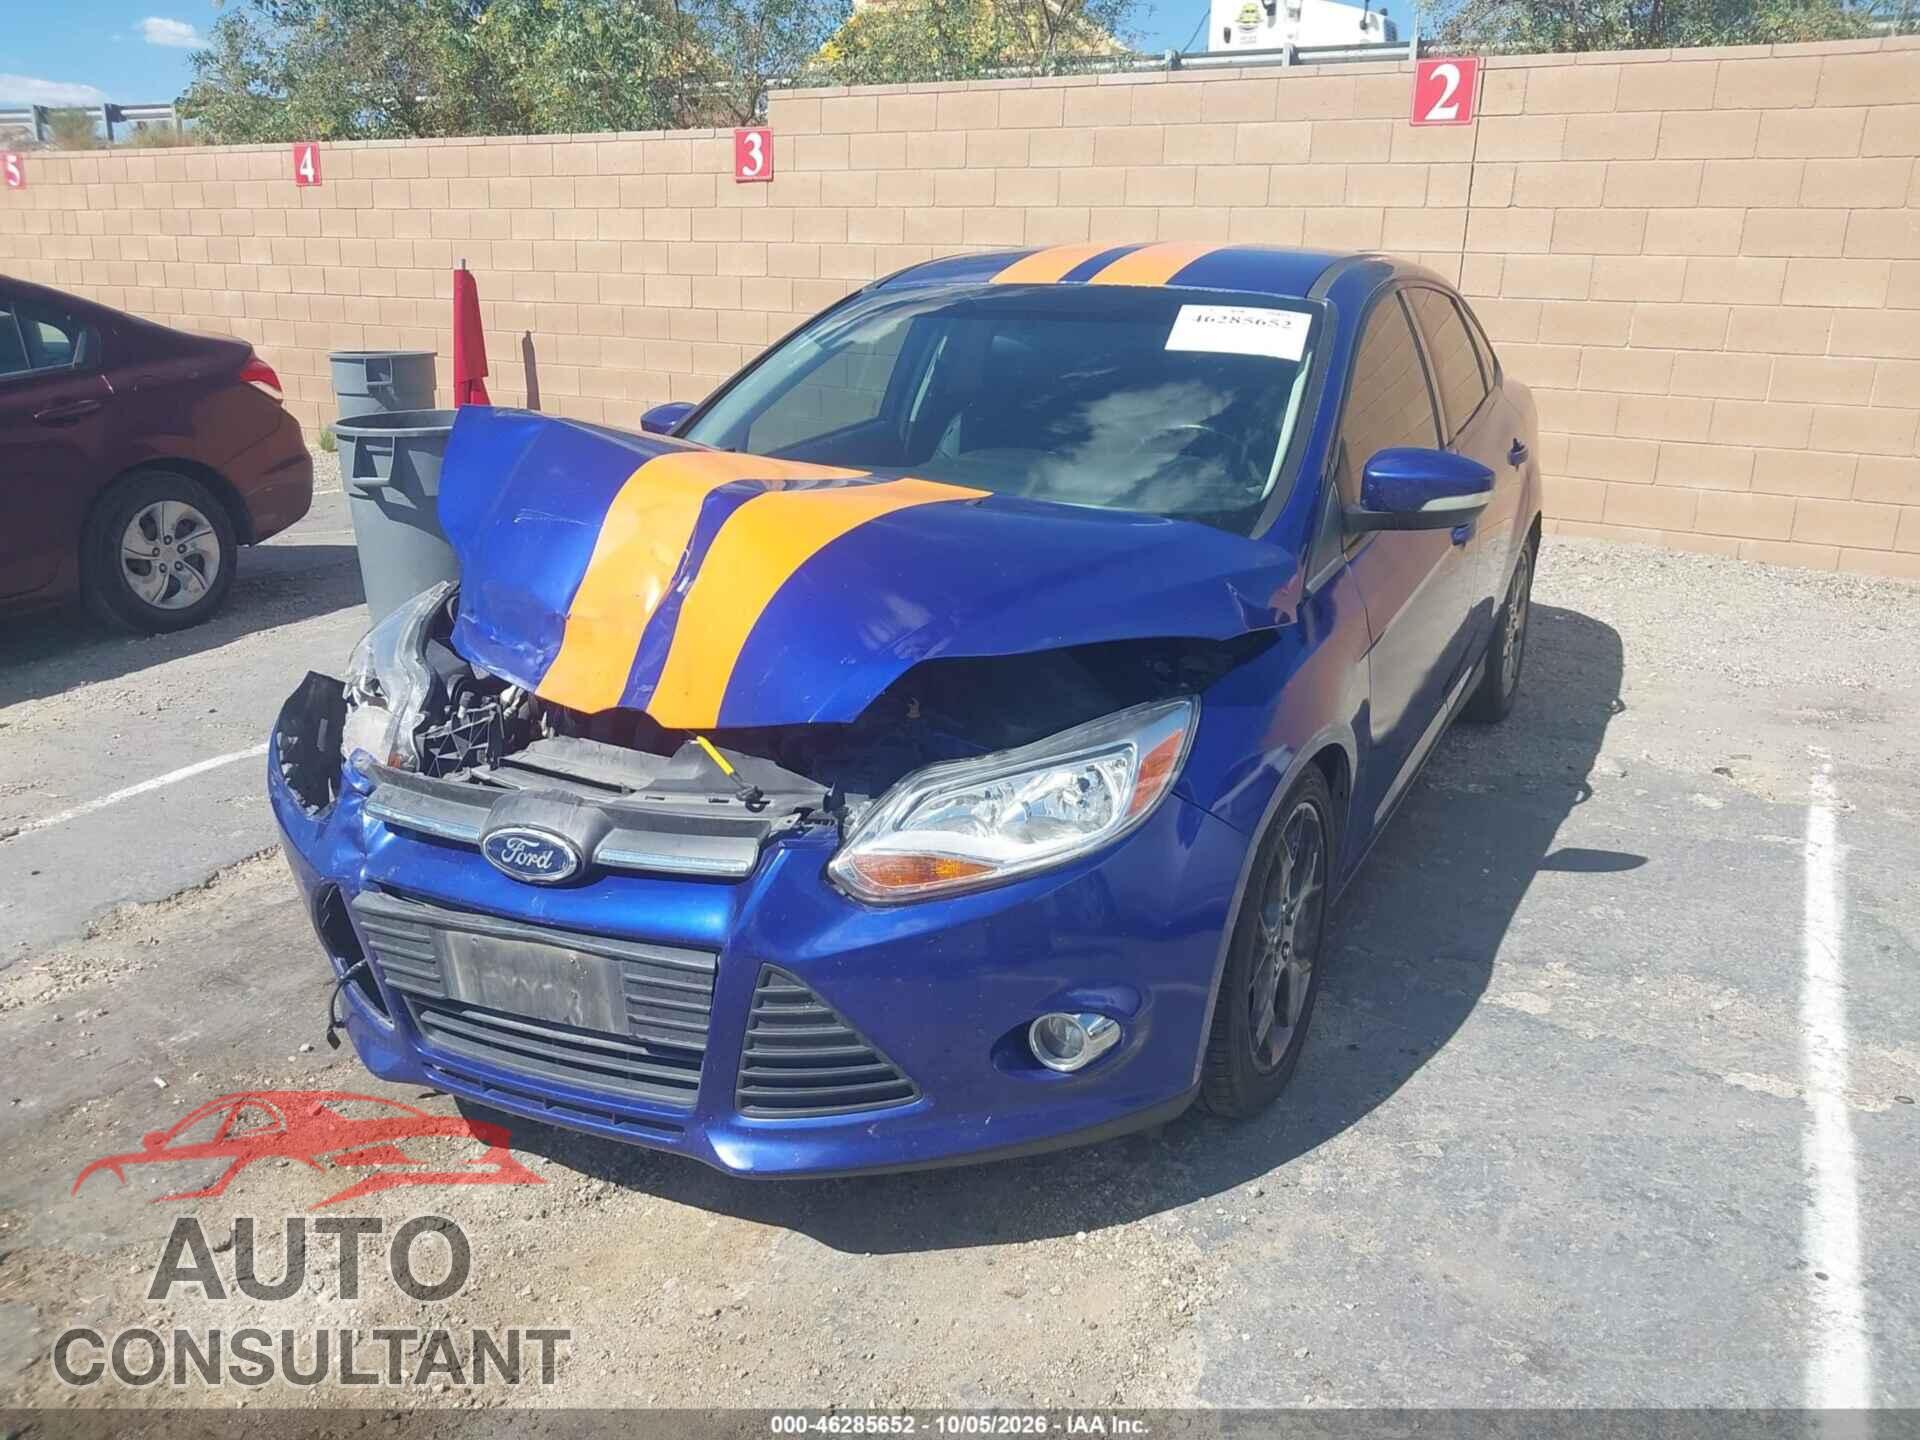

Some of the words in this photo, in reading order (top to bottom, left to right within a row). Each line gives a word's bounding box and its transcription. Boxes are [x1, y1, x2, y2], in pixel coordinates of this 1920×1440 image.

[1424, 63, 1460, 121] 2
[7, 155, 20, 186] 5
[300, 146, 314, 182] 4
[742, 132, 763, 176] 3
[501, 837, 554, 870] Ford
